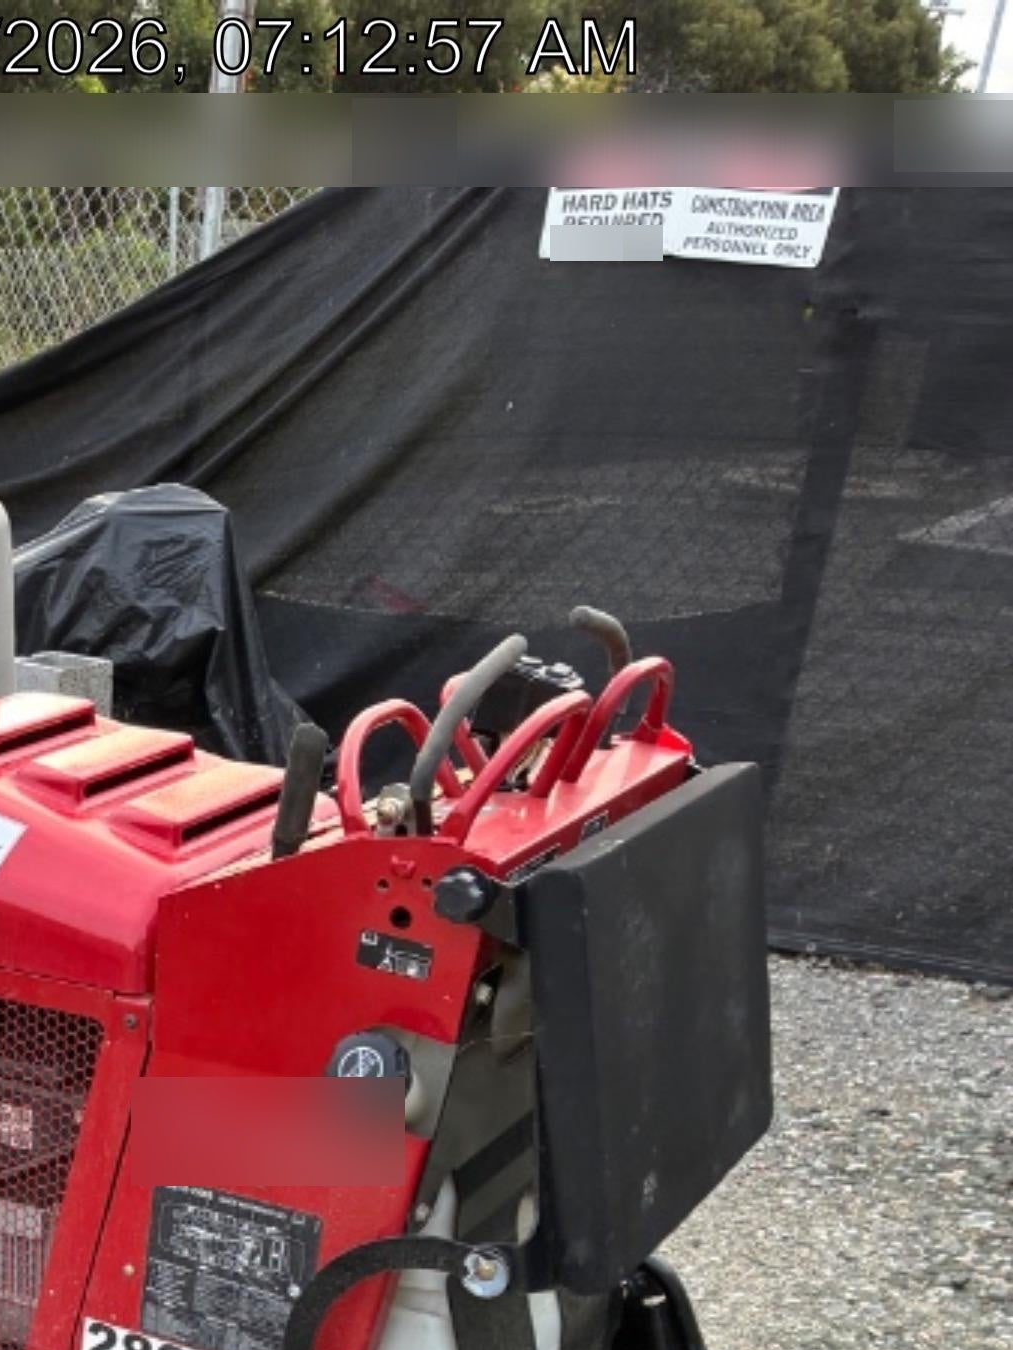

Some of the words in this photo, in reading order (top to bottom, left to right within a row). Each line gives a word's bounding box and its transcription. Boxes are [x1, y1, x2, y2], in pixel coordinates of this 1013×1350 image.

[562, 193, 617, 213] HARD
[622, 191, 672, 210] HATS
[691, 194, 789, 220] CONSTRUCTION
[791, 202, 825, 222] AREA
[705, 221, 798, 240] AUTHORIZED
[683, 236, 768, 255] PERSONNEL
[773, 243, 812, 259] ONLY
